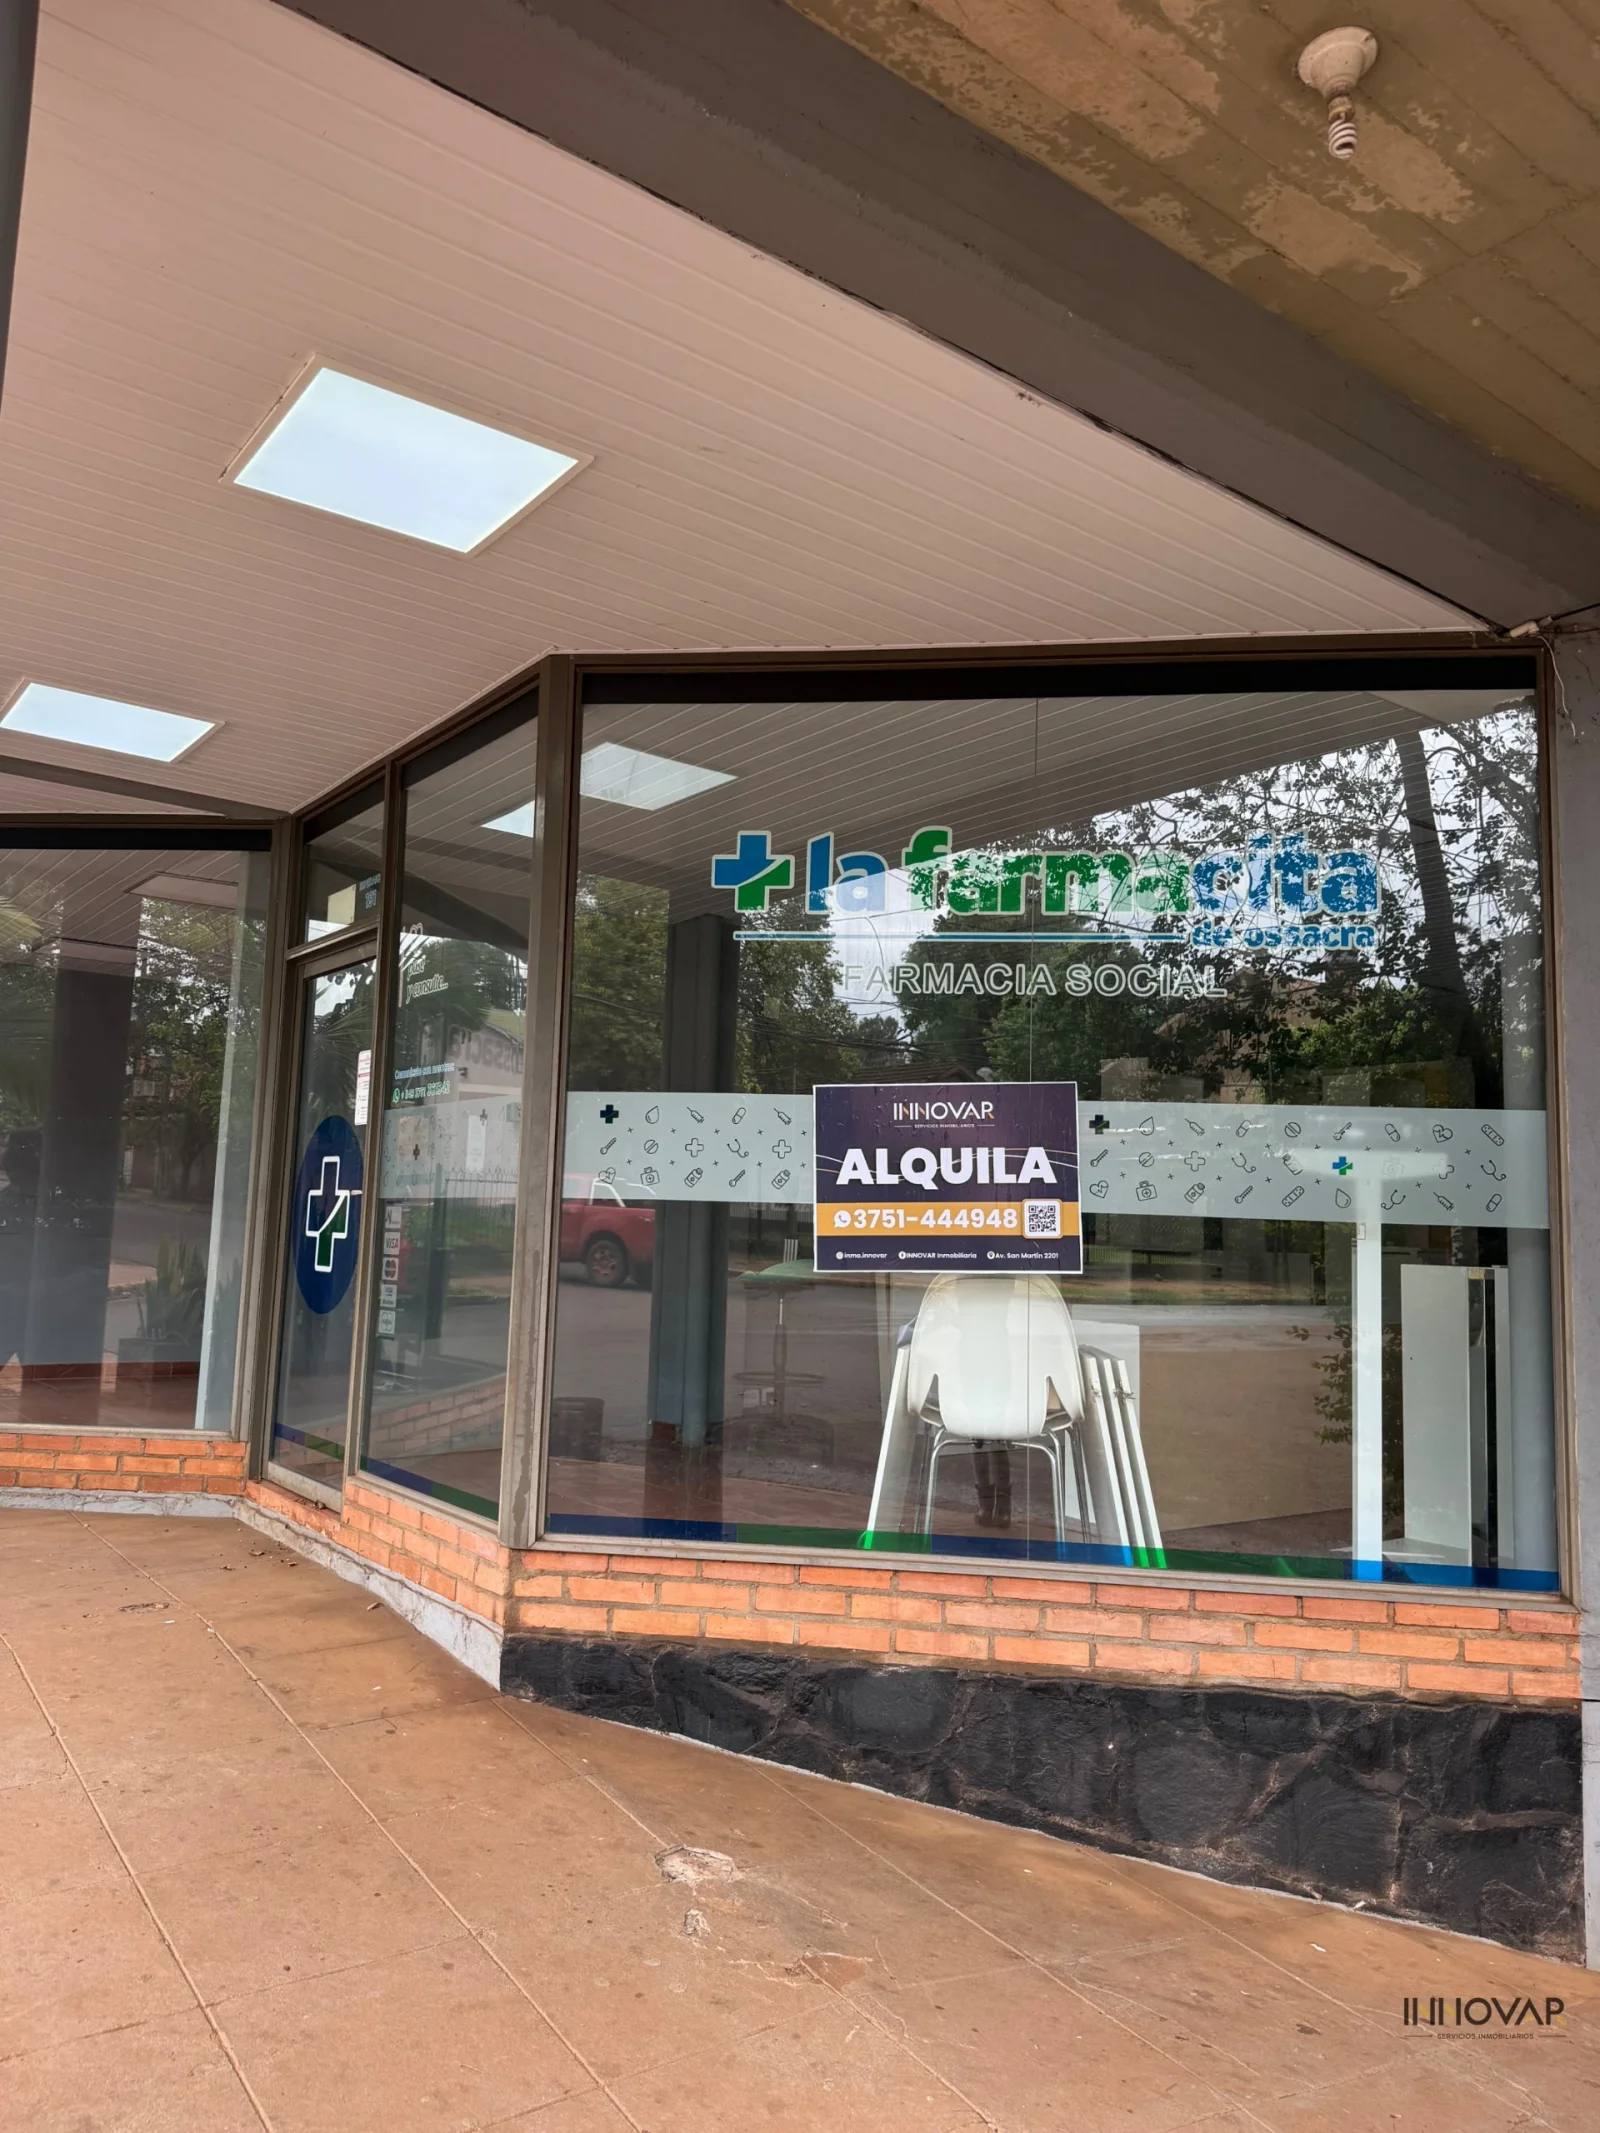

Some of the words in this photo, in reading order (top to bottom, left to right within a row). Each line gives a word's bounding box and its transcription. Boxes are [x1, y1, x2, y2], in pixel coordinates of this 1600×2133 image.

[1190, 918, 1235, 949] de
[1242, 925, 1378, 949] ossacra
[844, 963, 1057, 996] FARMACIA
[1064, 963, 1228, 997] SOCIAL
[893, 1101, 995, 1120] INNOVAR
[835, 1146, 1058, 1190] ALQUILA
[853, 1208, 1018, 1230] 3751-444948
